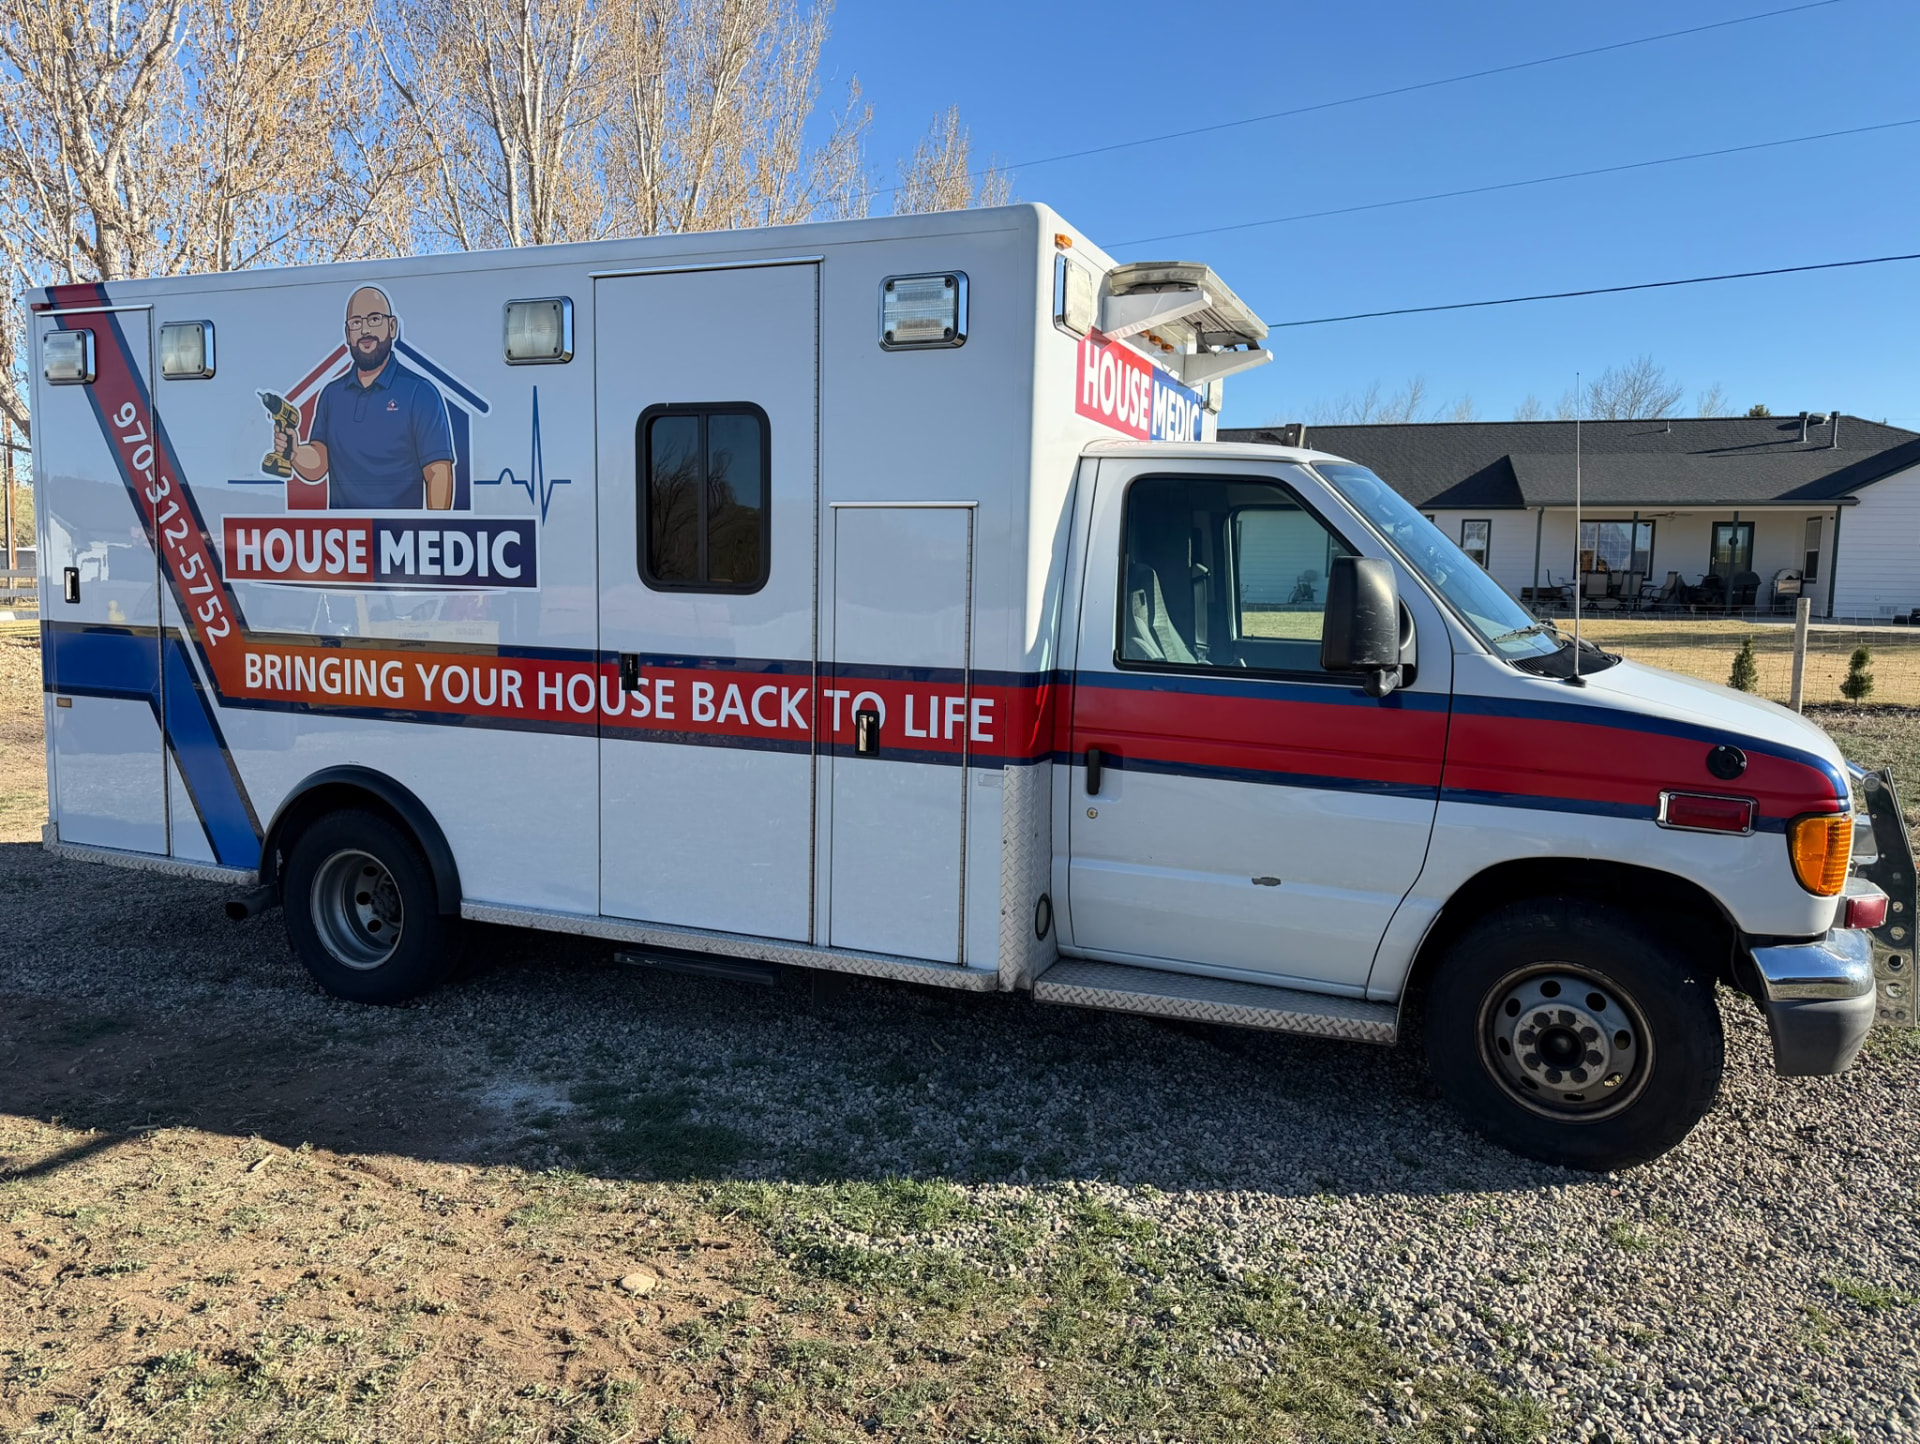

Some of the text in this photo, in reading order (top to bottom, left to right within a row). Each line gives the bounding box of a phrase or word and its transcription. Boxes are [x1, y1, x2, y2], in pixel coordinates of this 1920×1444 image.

[1083, 339, 1200, 442] HOUSE MEDIC
[112, 401, 231, 647] 970-312-5752
[235, 527, 522, 578] HOUSE MEDIC
[244, 652, 404, 698] BRINGING
[415, 662, 524, 709] YOUR
[537, 671, 675, 720] HOUSE
[692, 681, 809, 730] BACK
[904, 693, 995, 743] LIFE
